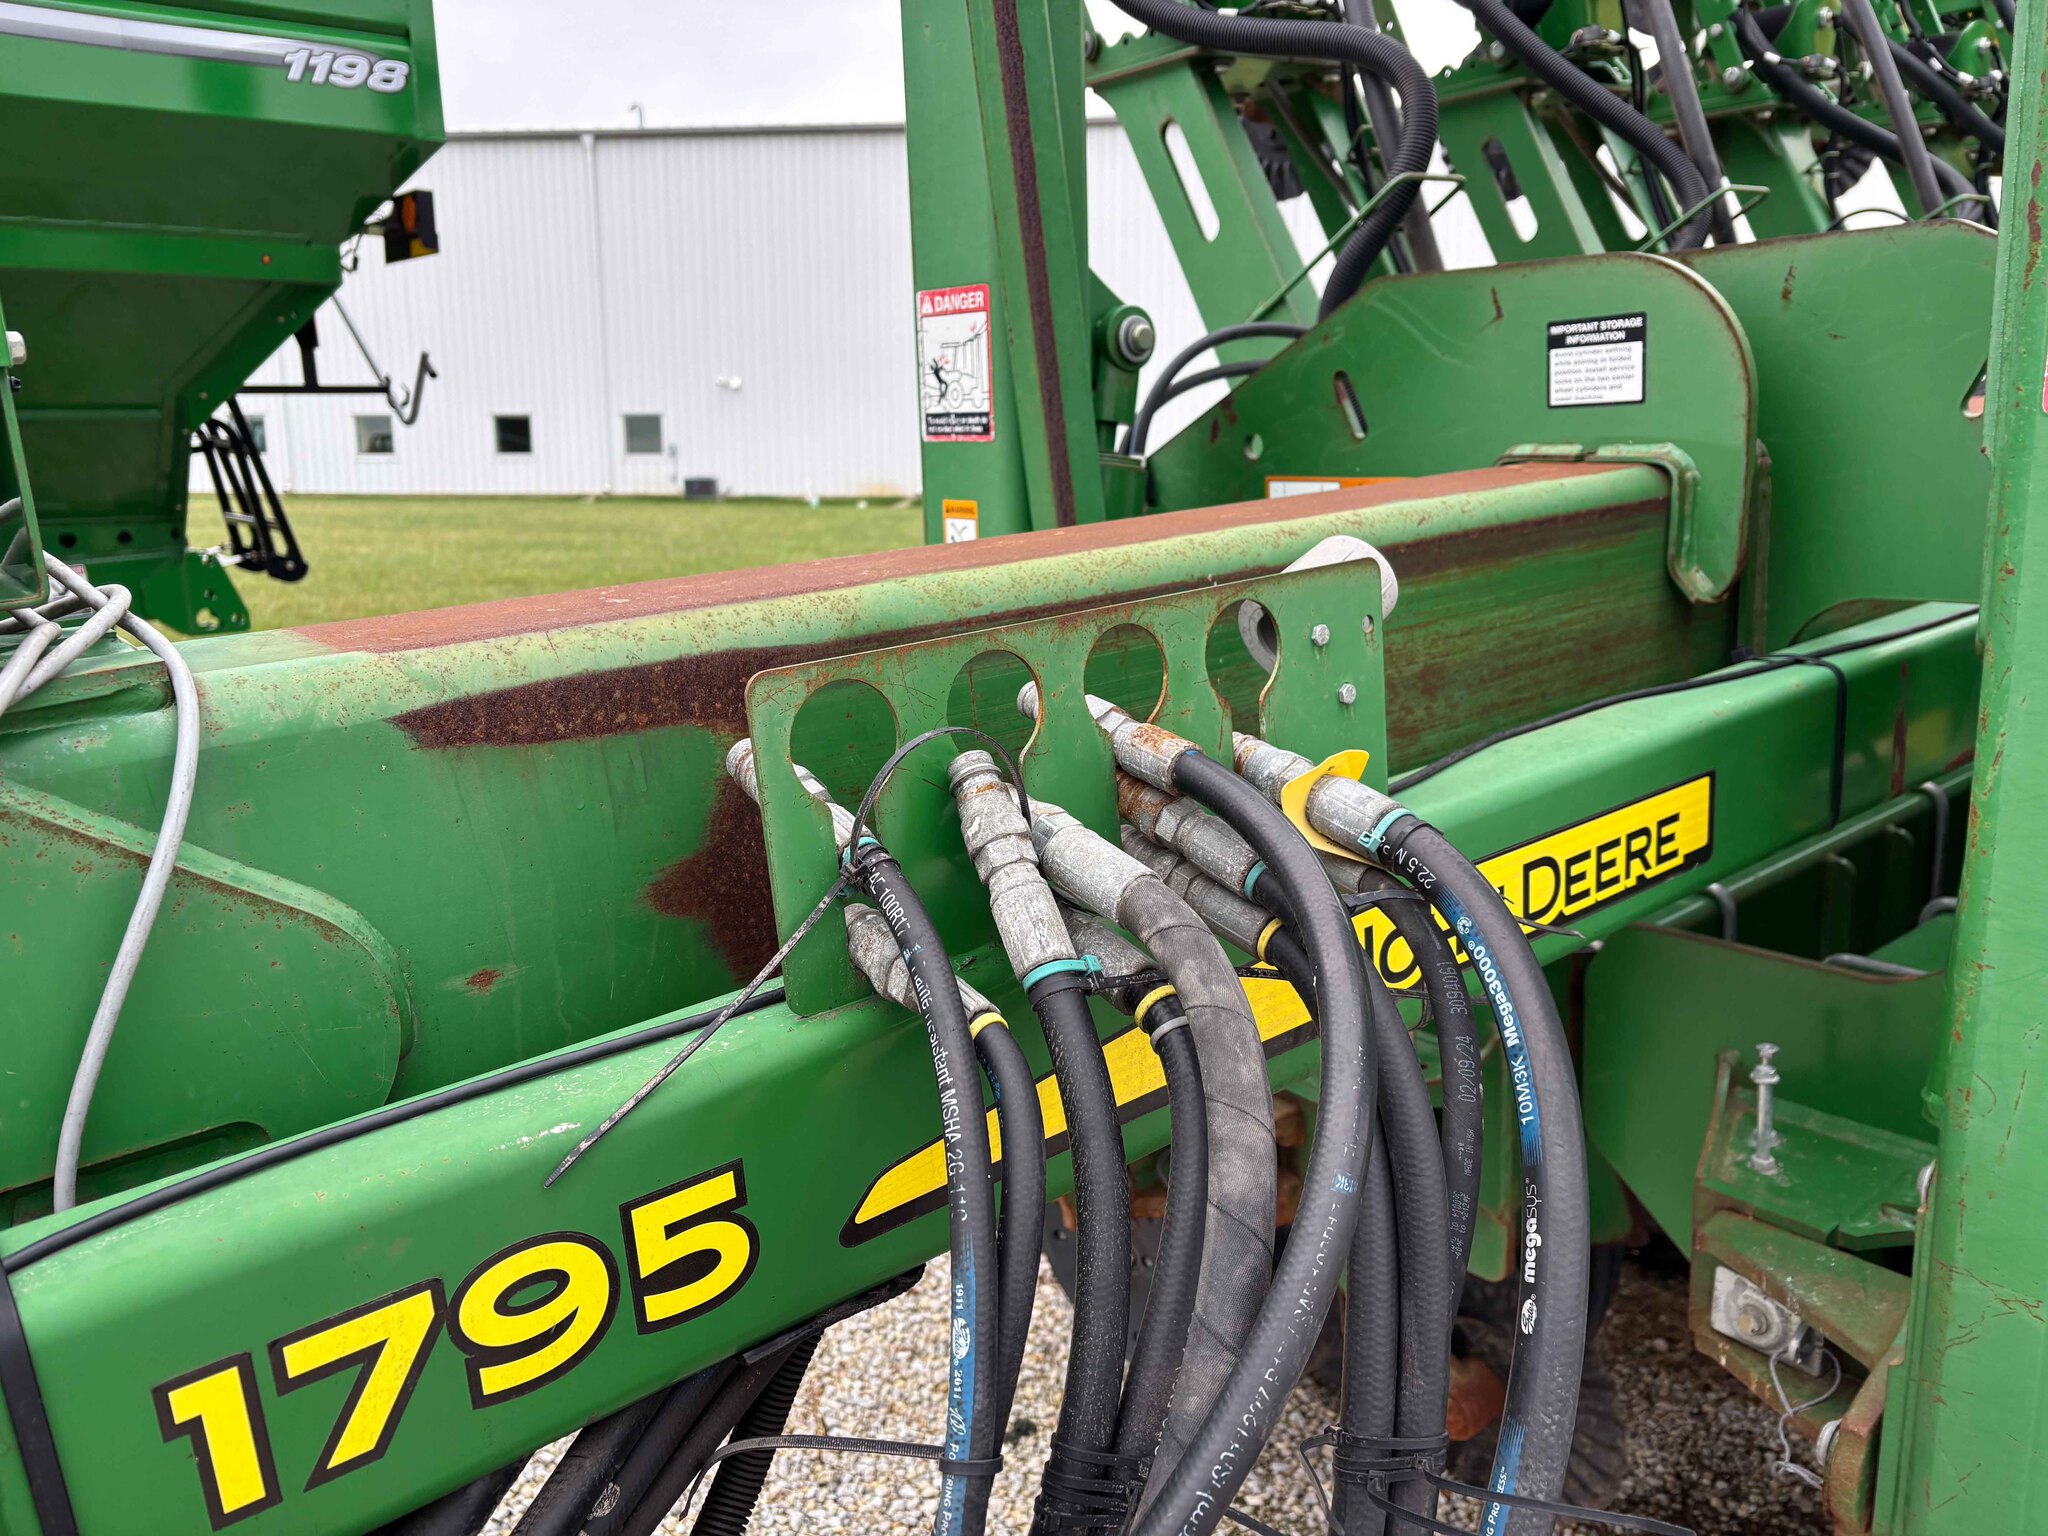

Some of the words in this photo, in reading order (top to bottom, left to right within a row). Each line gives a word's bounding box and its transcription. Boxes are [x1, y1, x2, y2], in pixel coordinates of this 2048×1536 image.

[284, 49, 410, 92] 1198
[934, 291, 984, 313] DANGER
[1550, 321, 1599, 335] IMPORTANT
[1600, 317, 1643, 331] STORAGE
[1566, 330, 1625, 345] INFORMATION
[1407, 857, 1437, 889] 22.5
[1523, 813, 1679, 920] DEERE
[1511, 1055, 1534, 1125] 10M3K
[955, 1283, 964, 1310] 1911
[160, 1165, 756, 1521] 1795
